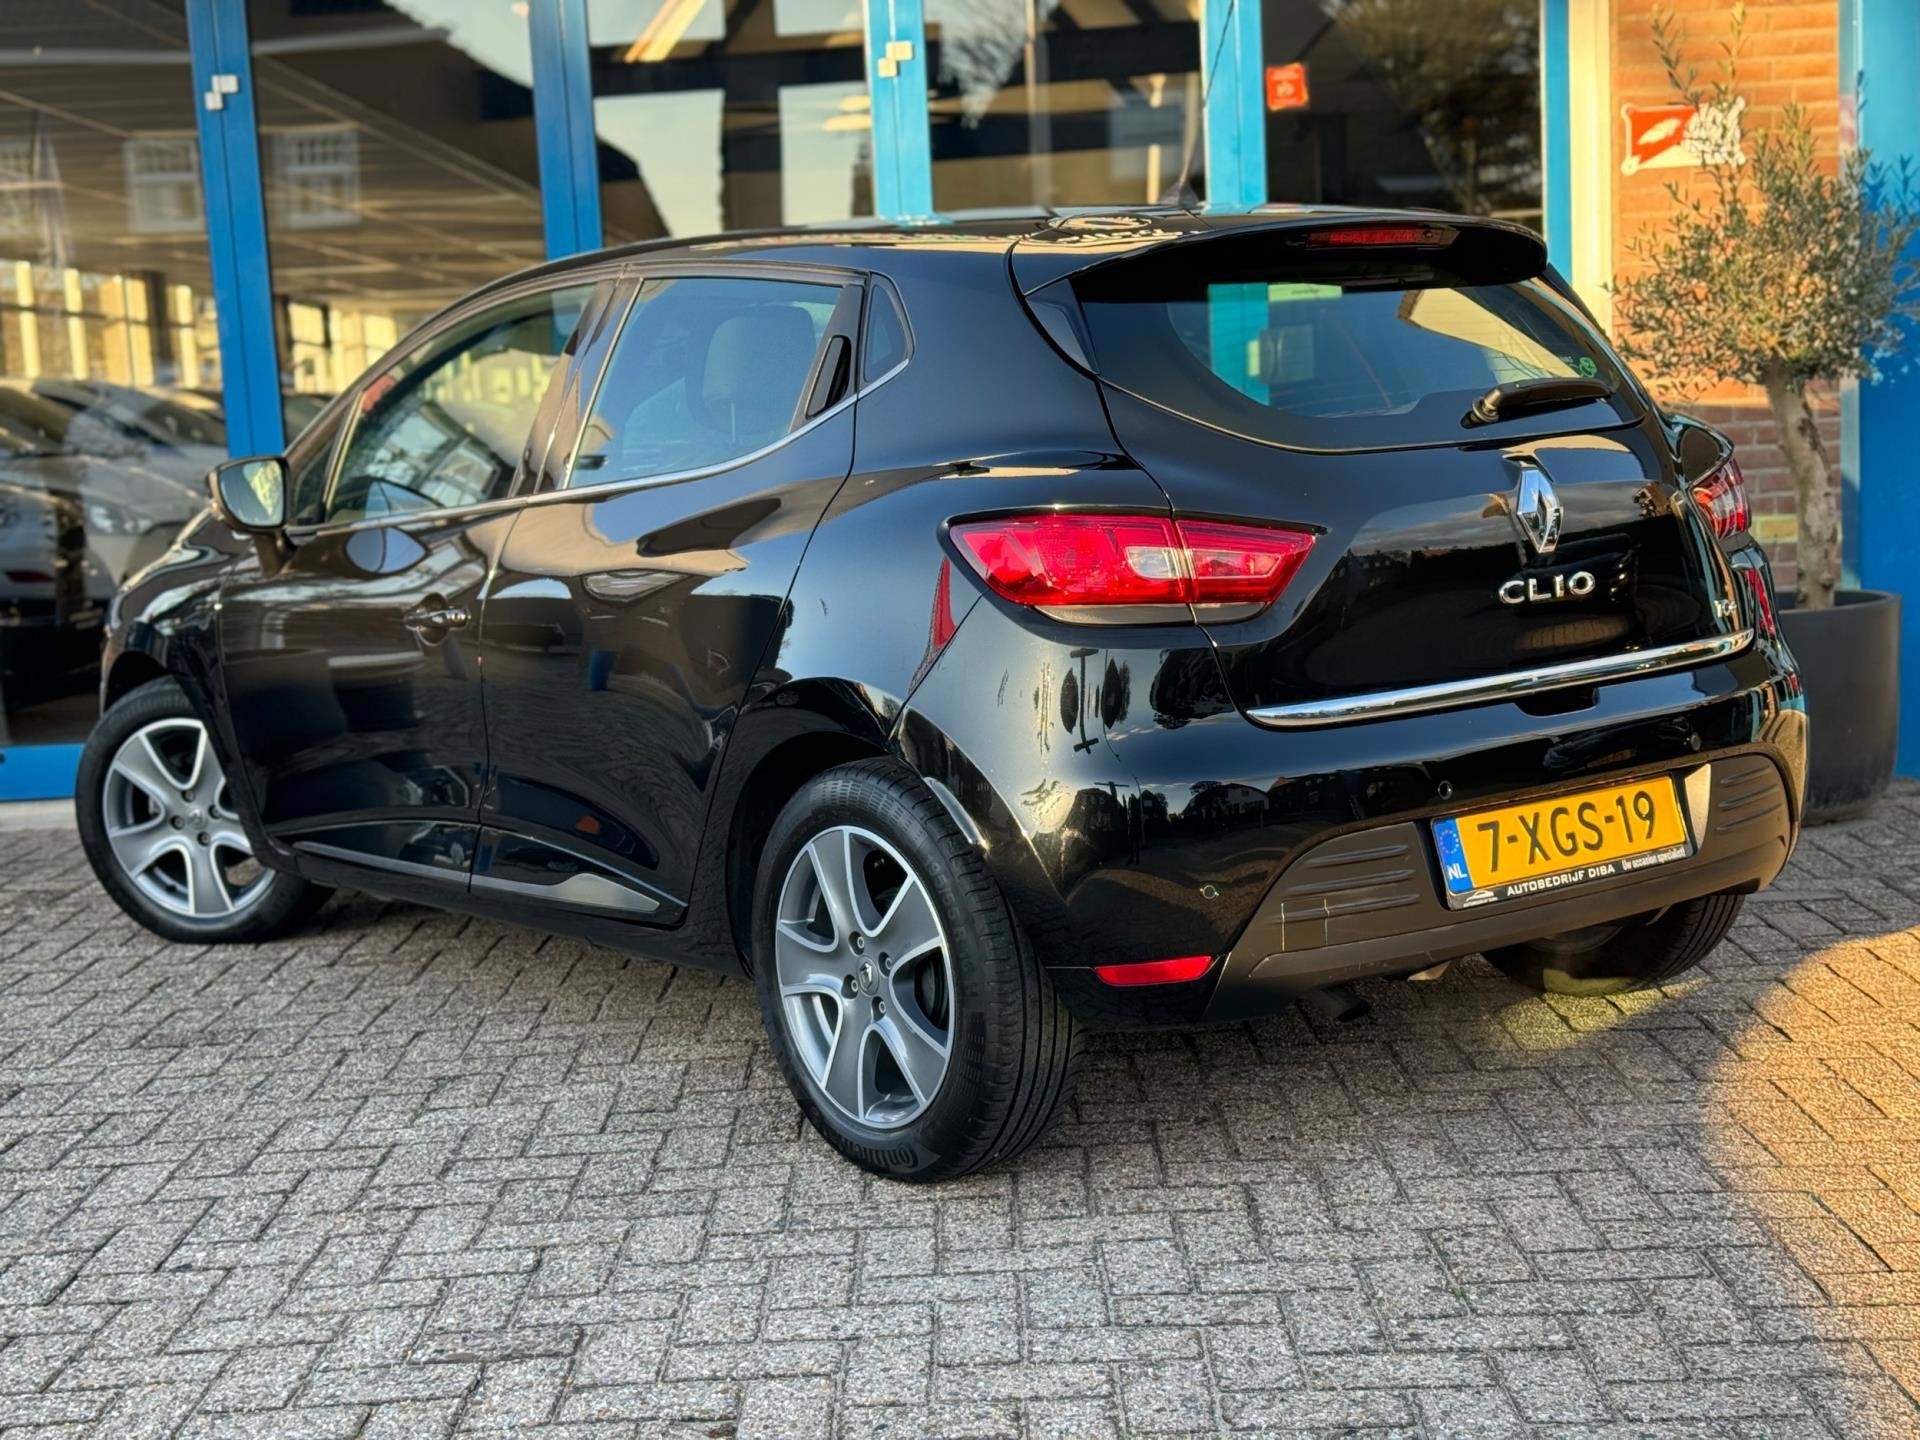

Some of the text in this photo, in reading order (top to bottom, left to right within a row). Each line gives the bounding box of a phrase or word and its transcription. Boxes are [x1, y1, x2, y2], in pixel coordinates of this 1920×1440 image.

[1499, 571, 1596, 604] CLIO
[1476, 790, 1655, 873] 7-XGS-19
[1447, 863, 1468, 881] NL
[1507, 863, 1616, 897] AUTOBEDRIJF DIBA
